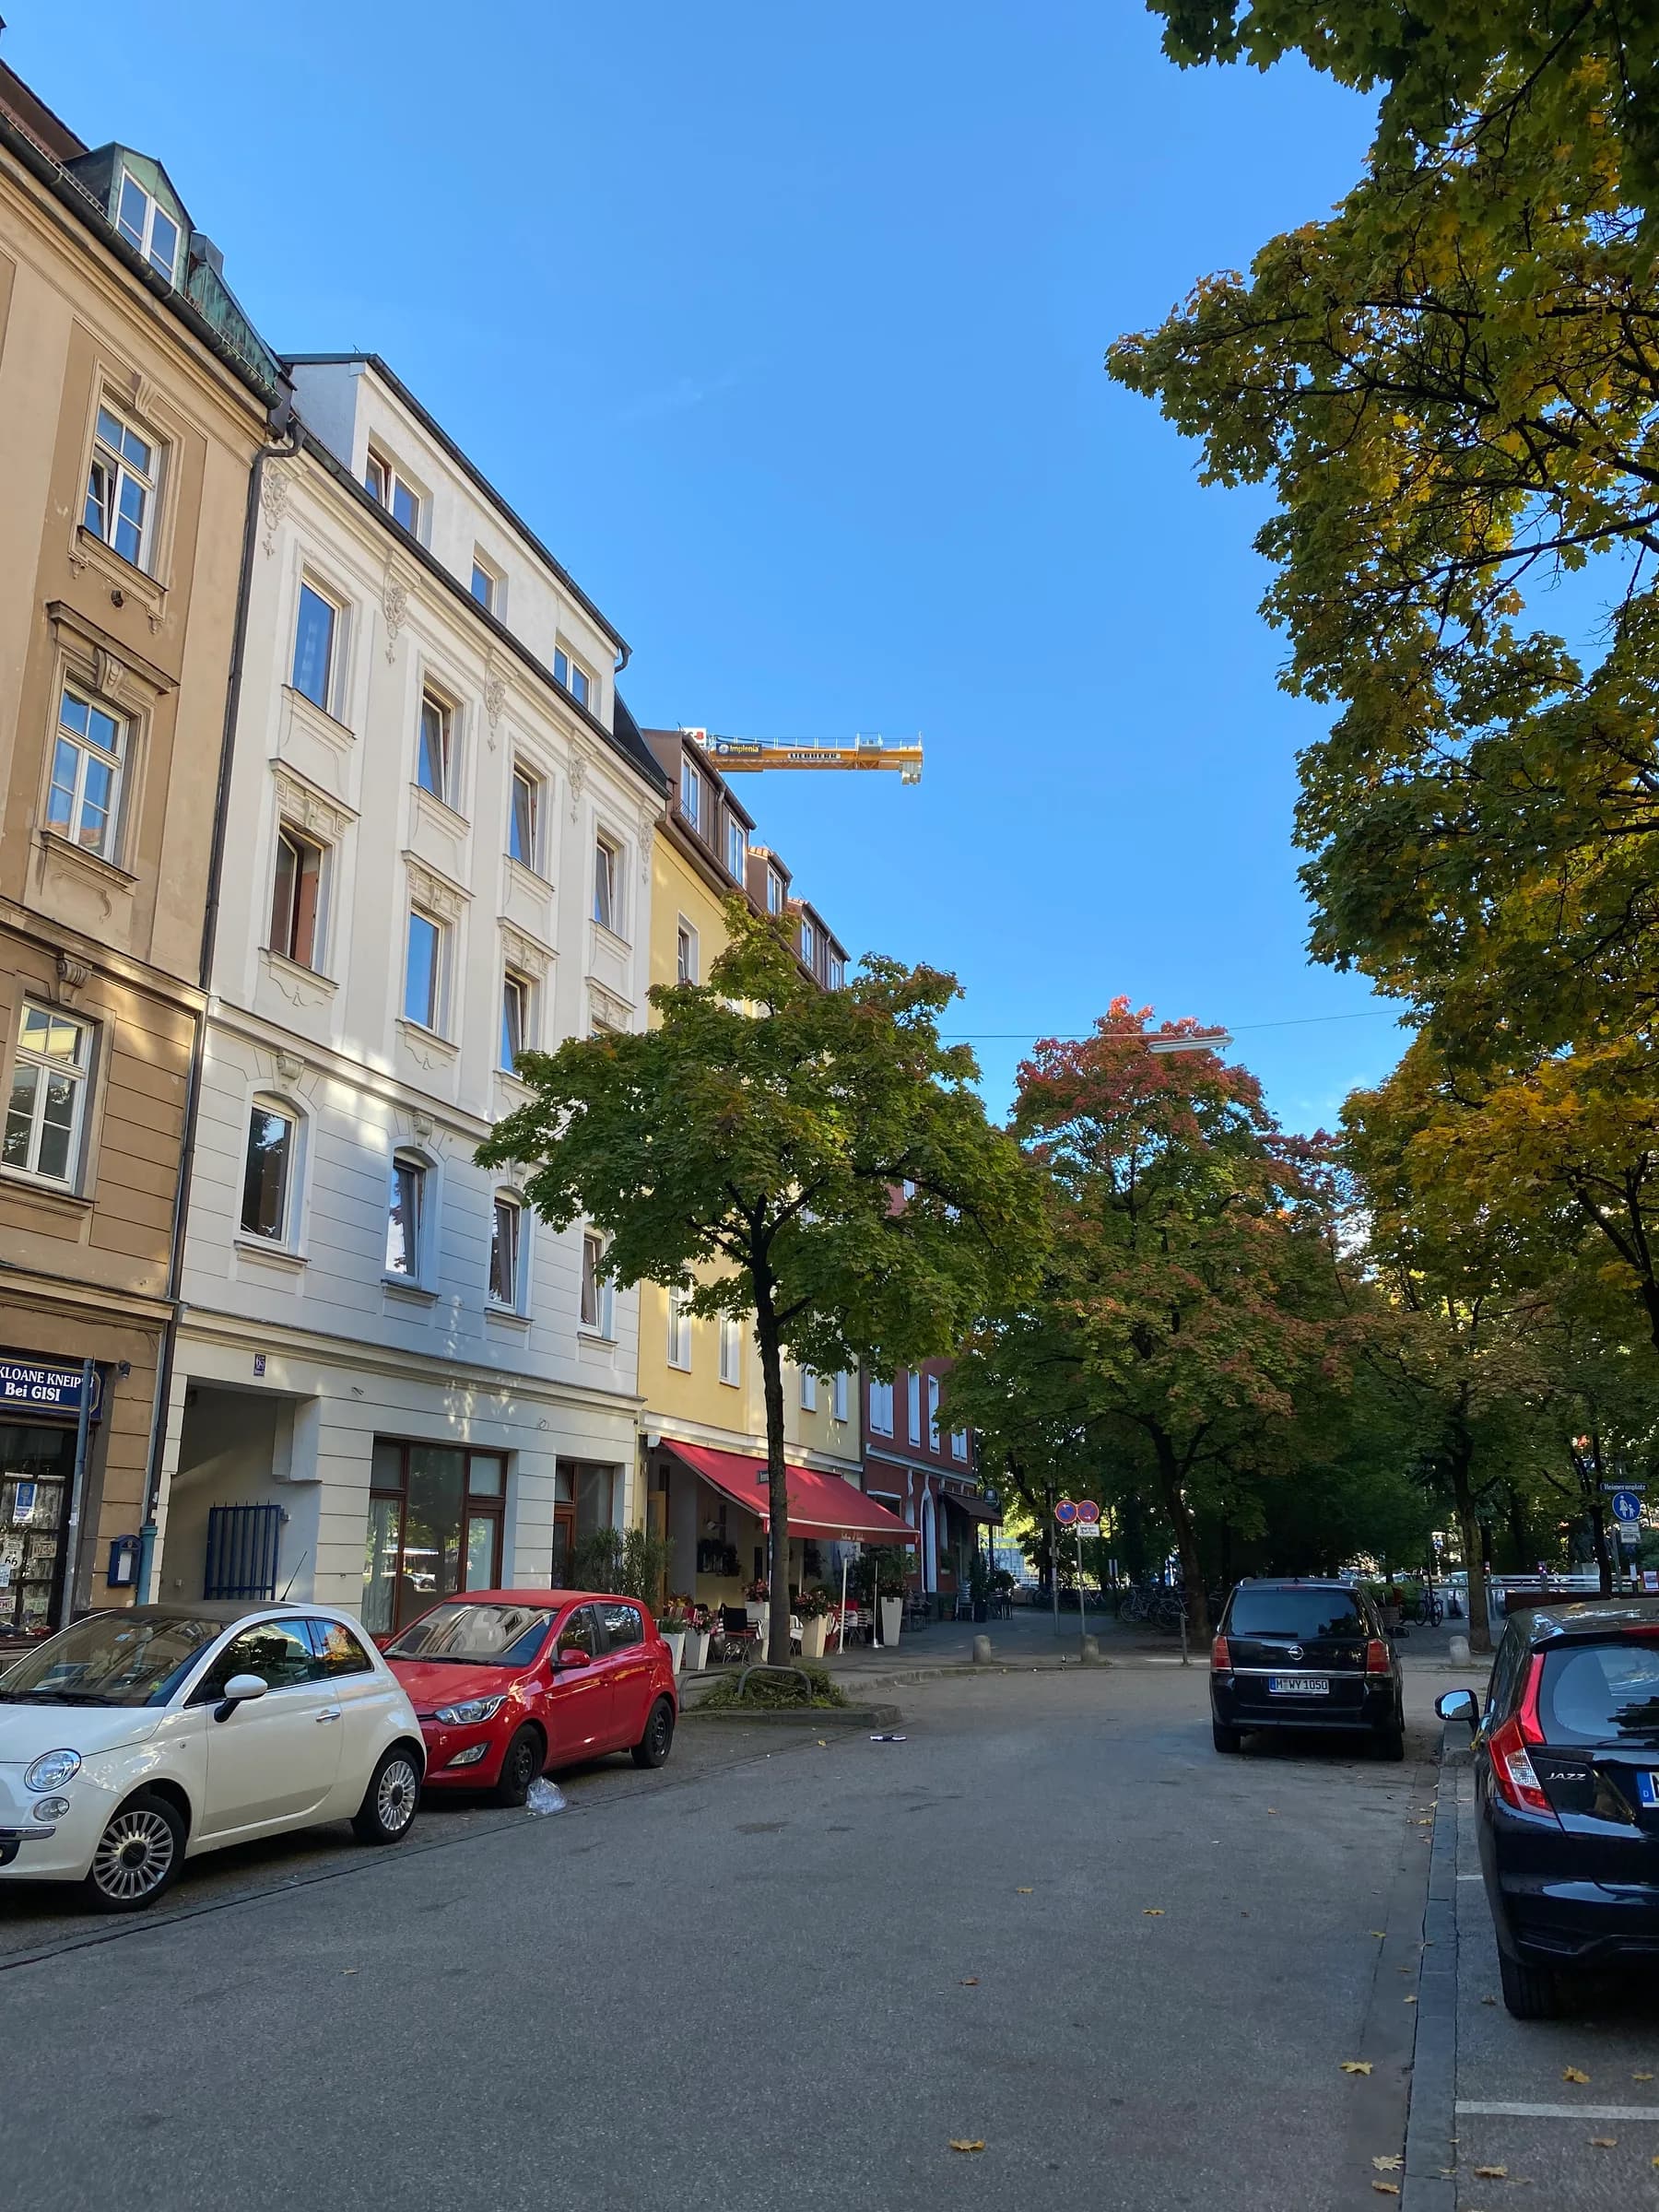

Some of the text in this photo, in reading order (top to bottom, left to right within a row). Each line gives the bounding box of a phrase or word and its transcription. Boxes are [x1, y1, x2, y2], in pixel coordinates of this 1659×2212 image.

[730, 744, 759, 754] Implenia
[0, 1366, 45, 1383] KLOANE
[5, 1382, 61, 1401] Bei GISI
[1276, 1679, 1327, 1690] M WY 1050
[1546, 1771, 1586, 1781] JAZZ
[1642, 1790, 1650, 1798] D
